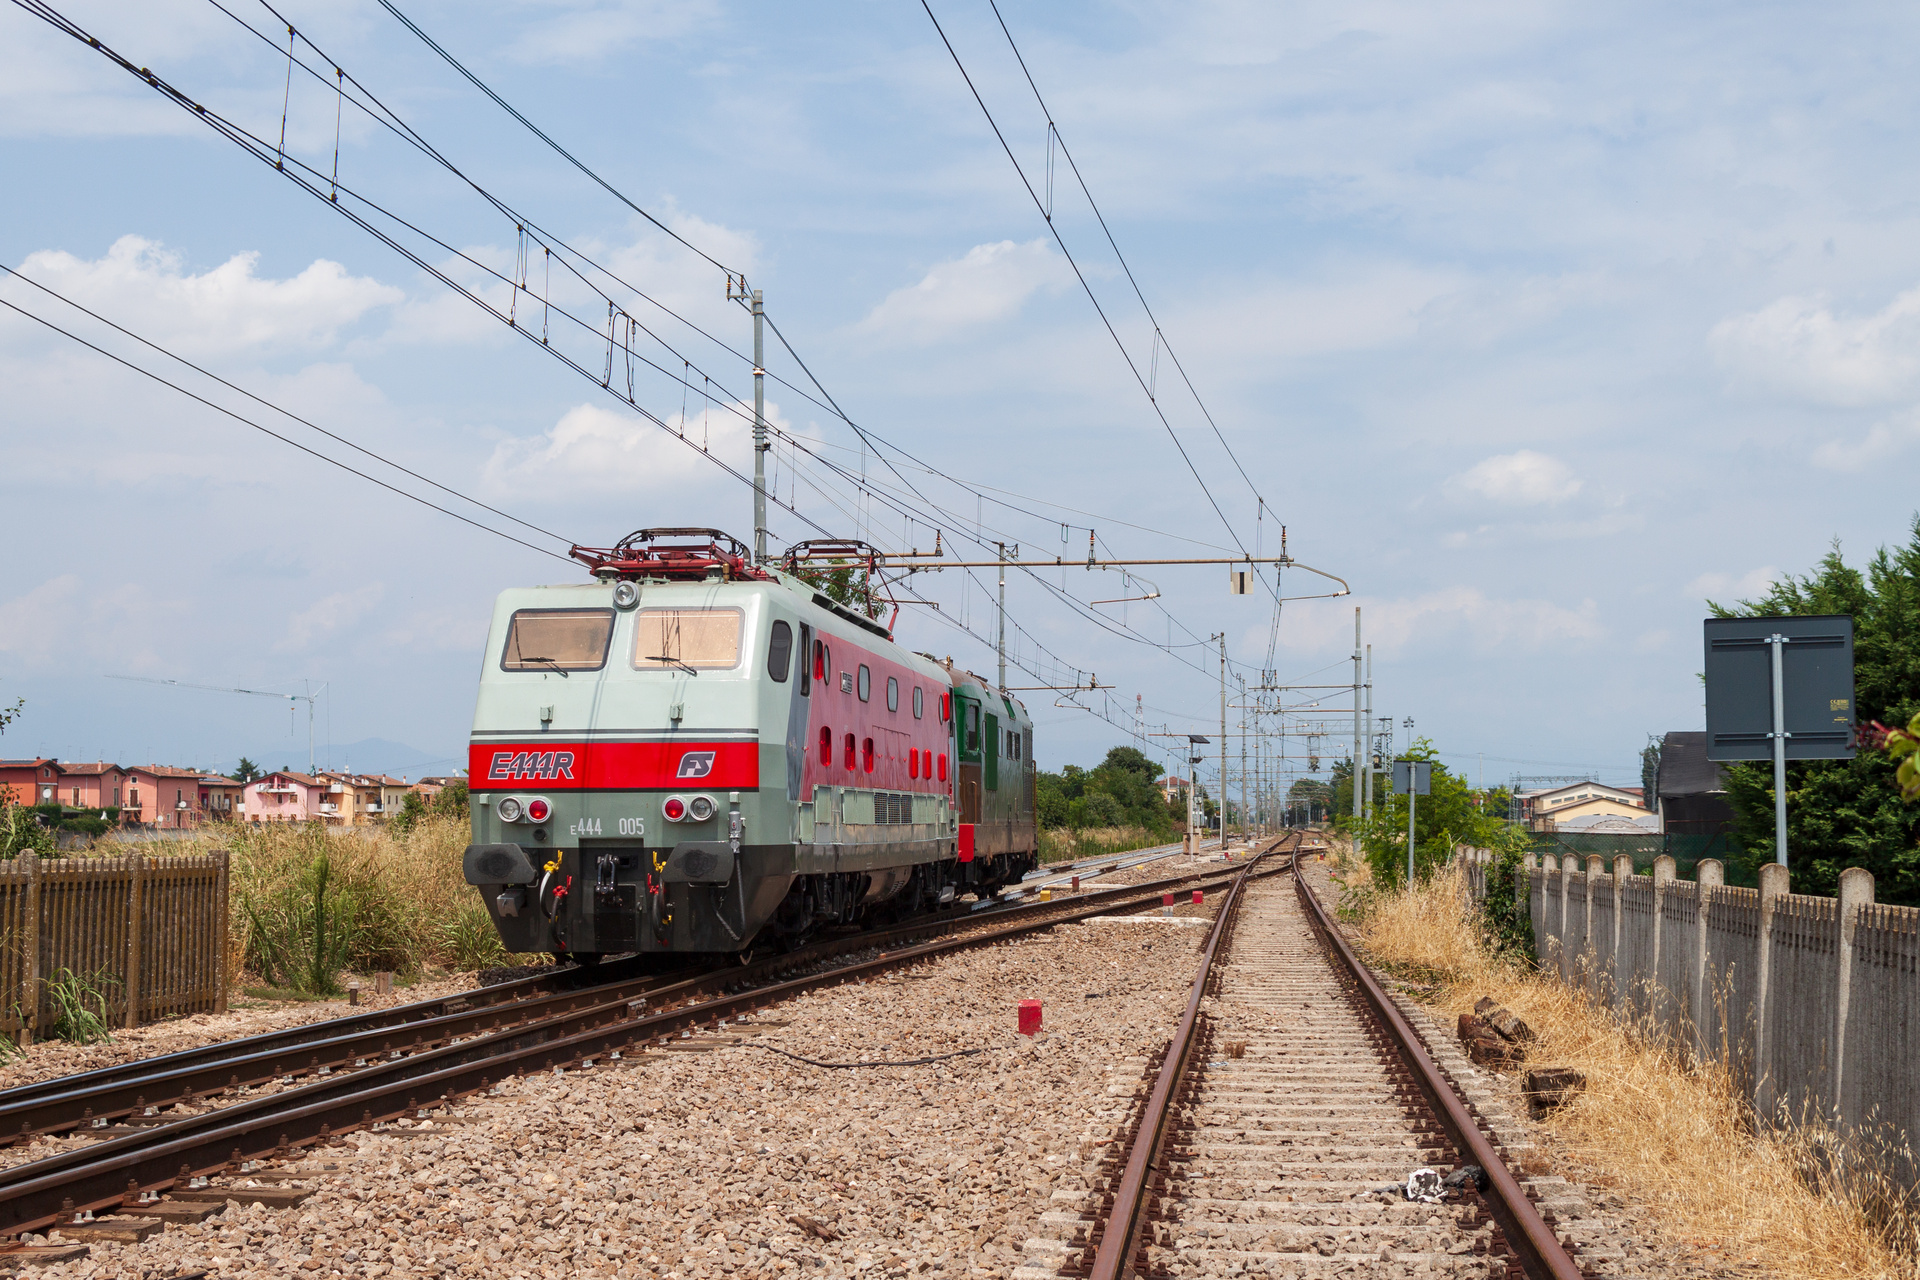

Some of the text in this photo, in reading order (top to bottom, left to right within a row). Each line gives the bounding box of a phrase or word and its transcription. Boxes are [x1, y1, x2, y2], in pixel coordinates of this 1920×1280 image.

[488, 752, 574, 779] E444R
[677, 752, 715, 777] FS
[619, 818, 644, 835] 005
